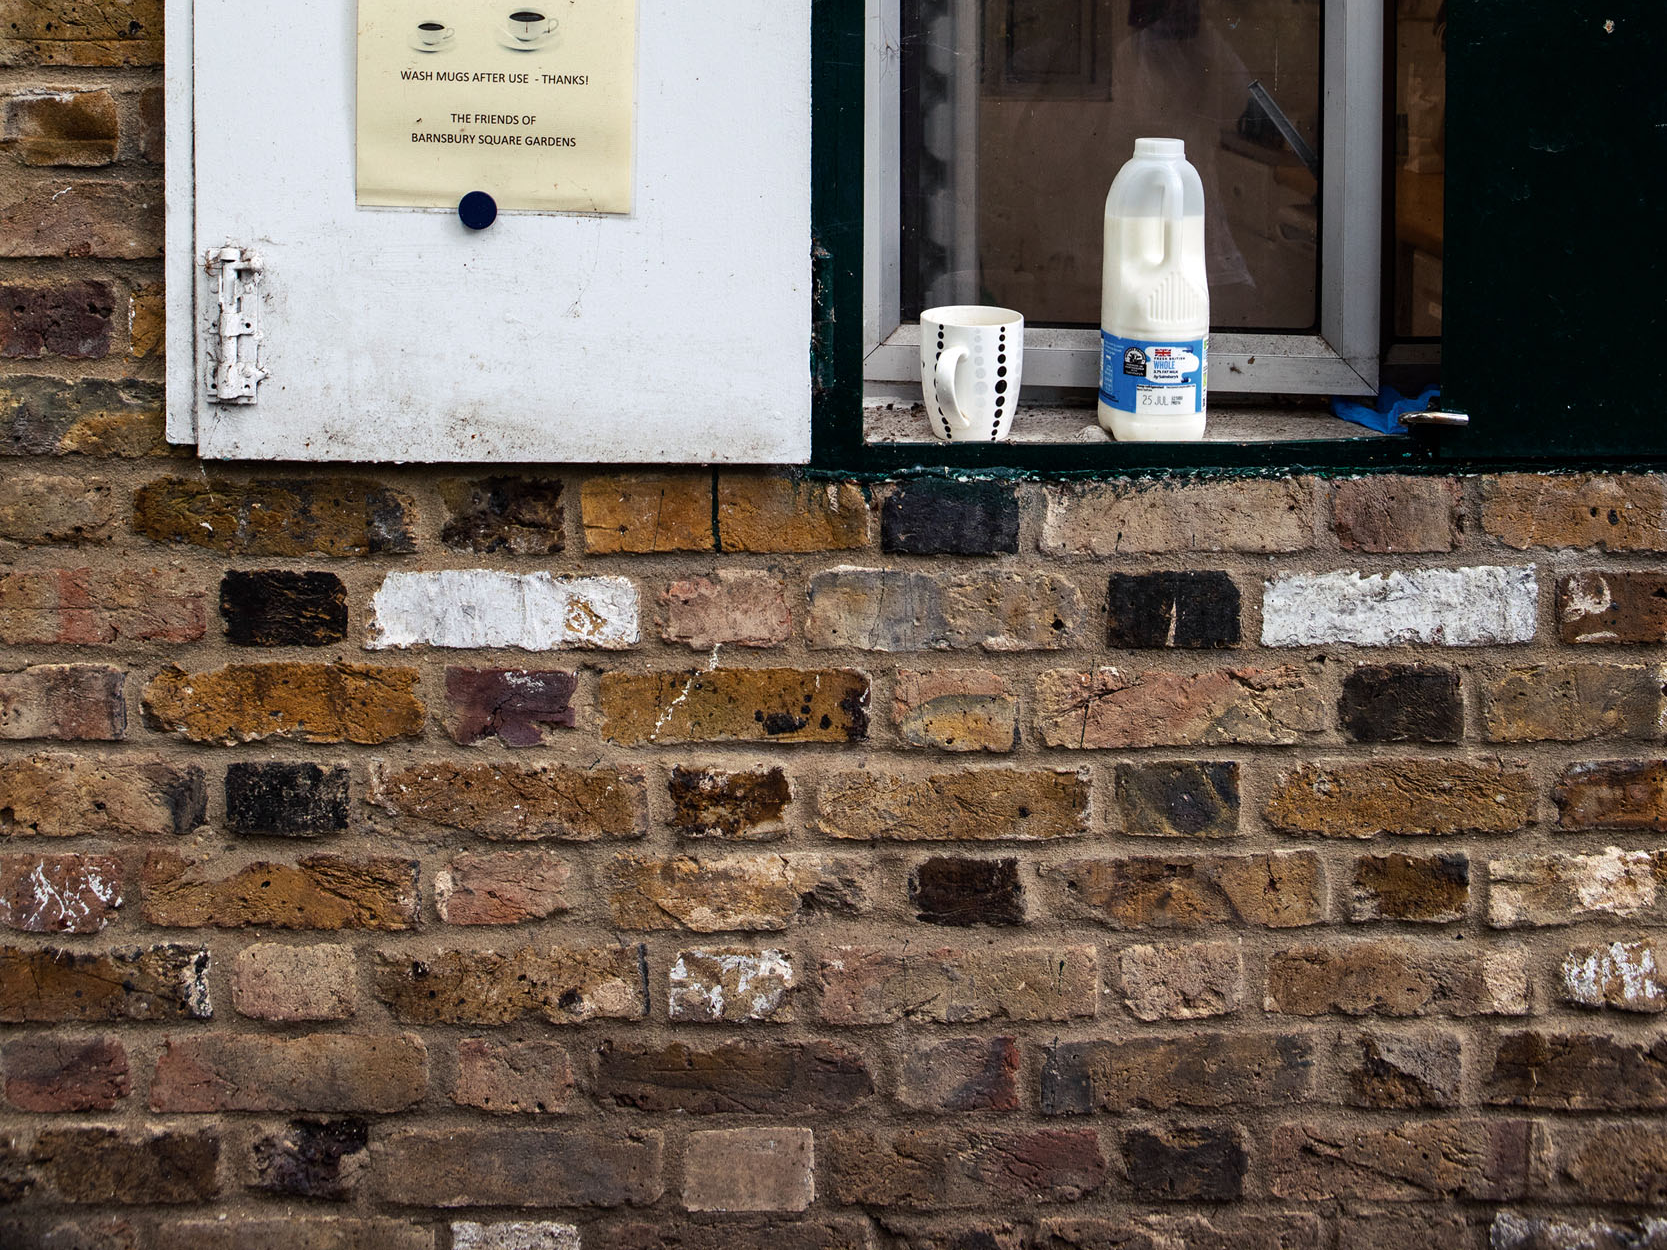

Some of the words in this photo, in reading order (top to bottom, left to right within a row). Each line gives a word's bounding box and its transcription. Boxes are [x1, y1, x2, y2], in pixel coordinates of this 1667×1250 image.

[400, 70, 433, 82] WASH
[436, 71, 470, 83] MUGS
[472, 72, 506, 84] AFTER
[508, 73, 529, 85] USE
[541, 74, 589, 86] THANKS!
[450, 113, 472, 125] THE
[474, 114, 519, 126] FRIENDS
[521, 114, 537, 126] OF
[411, 133, 476, 145] BARNSBURY
[478, 134, 522, 147] SQUARE
[524, 135, 577, 148] GARDENS
[1153, 360, 1175, 370] WHOLE
[1142, 394, 1152, 406] 25
[1154, 395, 1169, 406] JUL
